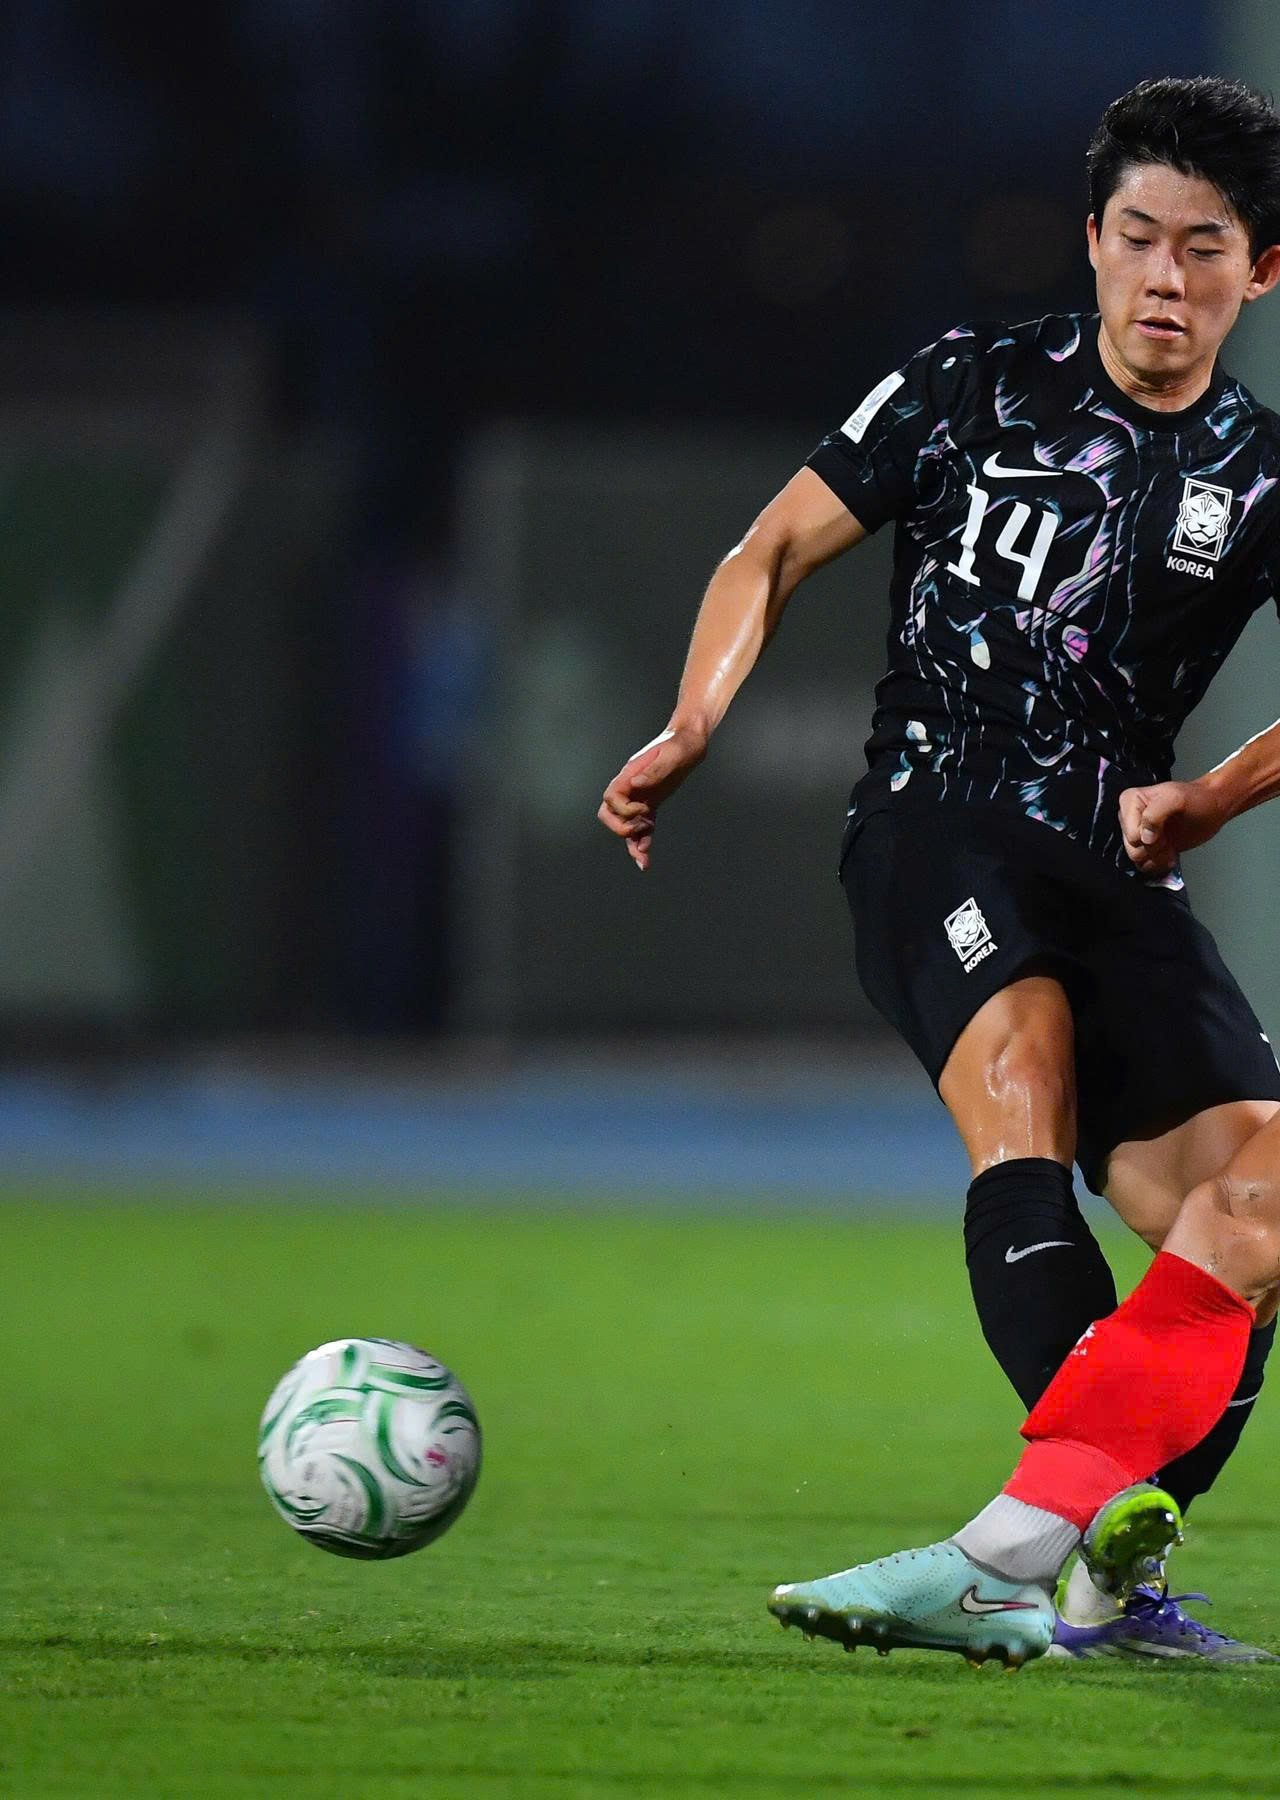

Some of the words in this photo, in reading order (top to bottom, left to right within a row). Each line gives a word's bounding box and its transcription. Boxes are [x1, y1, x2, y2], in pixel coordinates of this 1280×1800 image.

[947, 483, 1060, 603] 14
[1165, 555, 1215, 581] KOREA
[963, 941, 999, 974] KOREA
